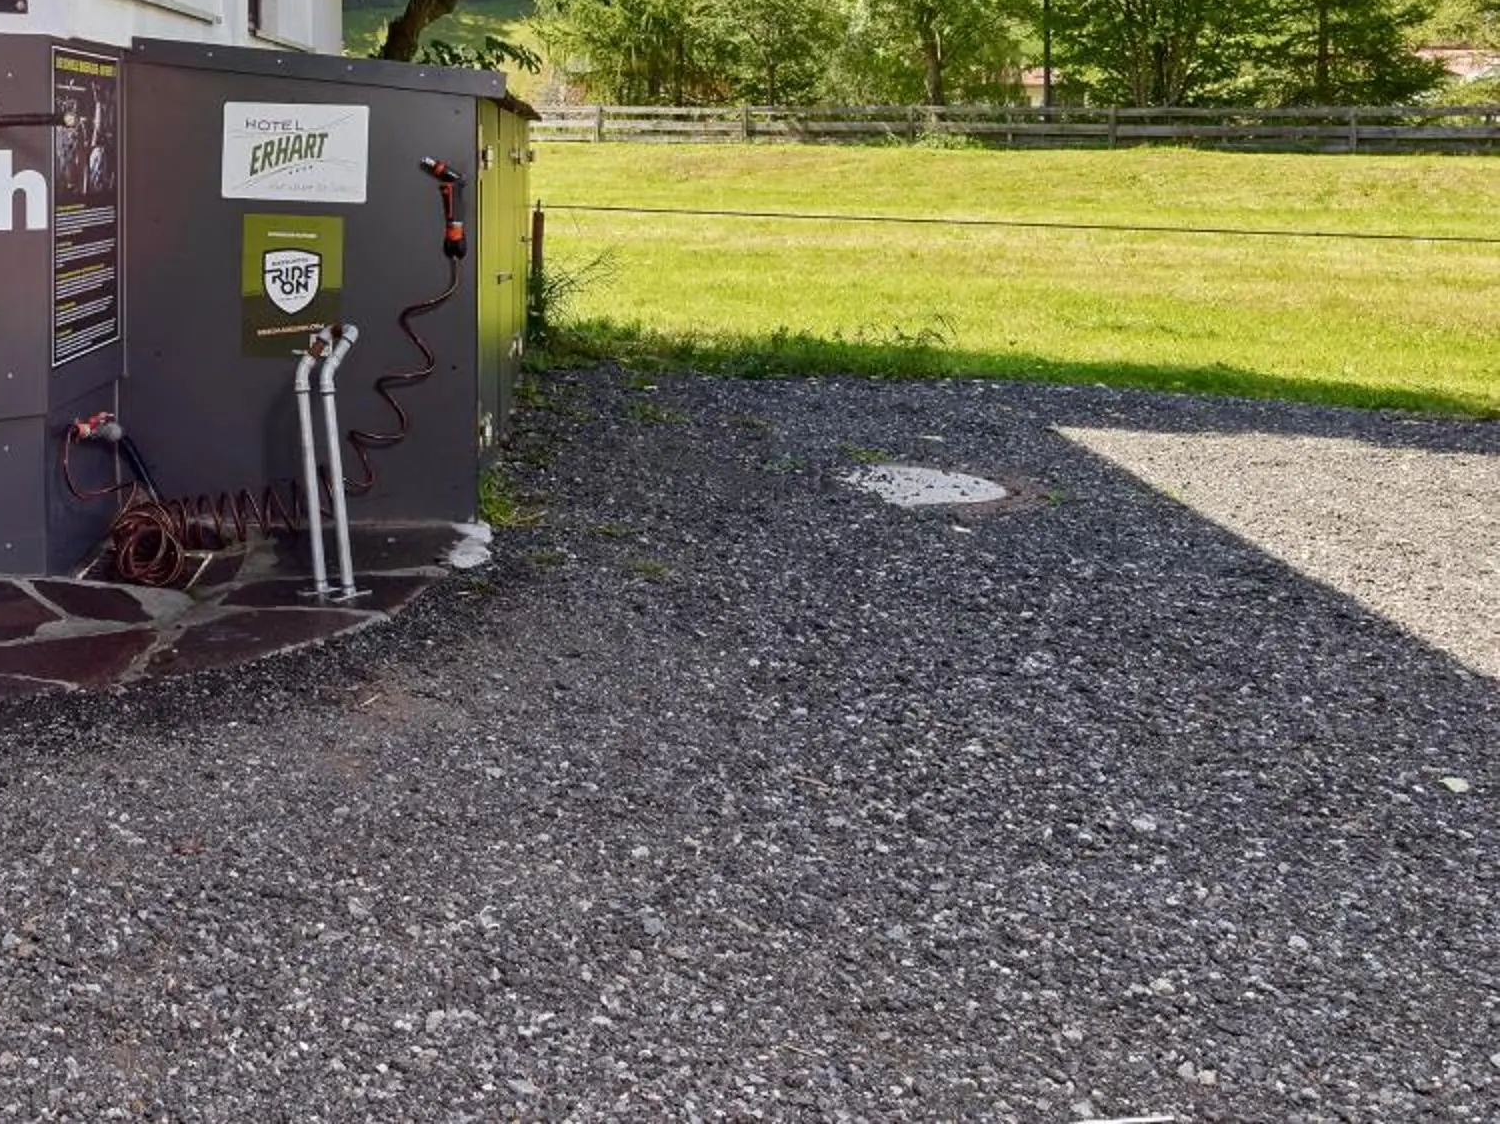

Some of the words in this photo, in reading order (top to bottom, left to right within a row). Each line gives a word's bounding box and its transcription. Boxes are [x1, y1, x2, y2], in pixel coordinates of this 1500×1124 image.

[244, 118, 305, 132] HOTEL
[249, 132, 329, 177] ERHART
[265, 264, 316, 284] RIDE
[281, 280, 309, 295] ON
